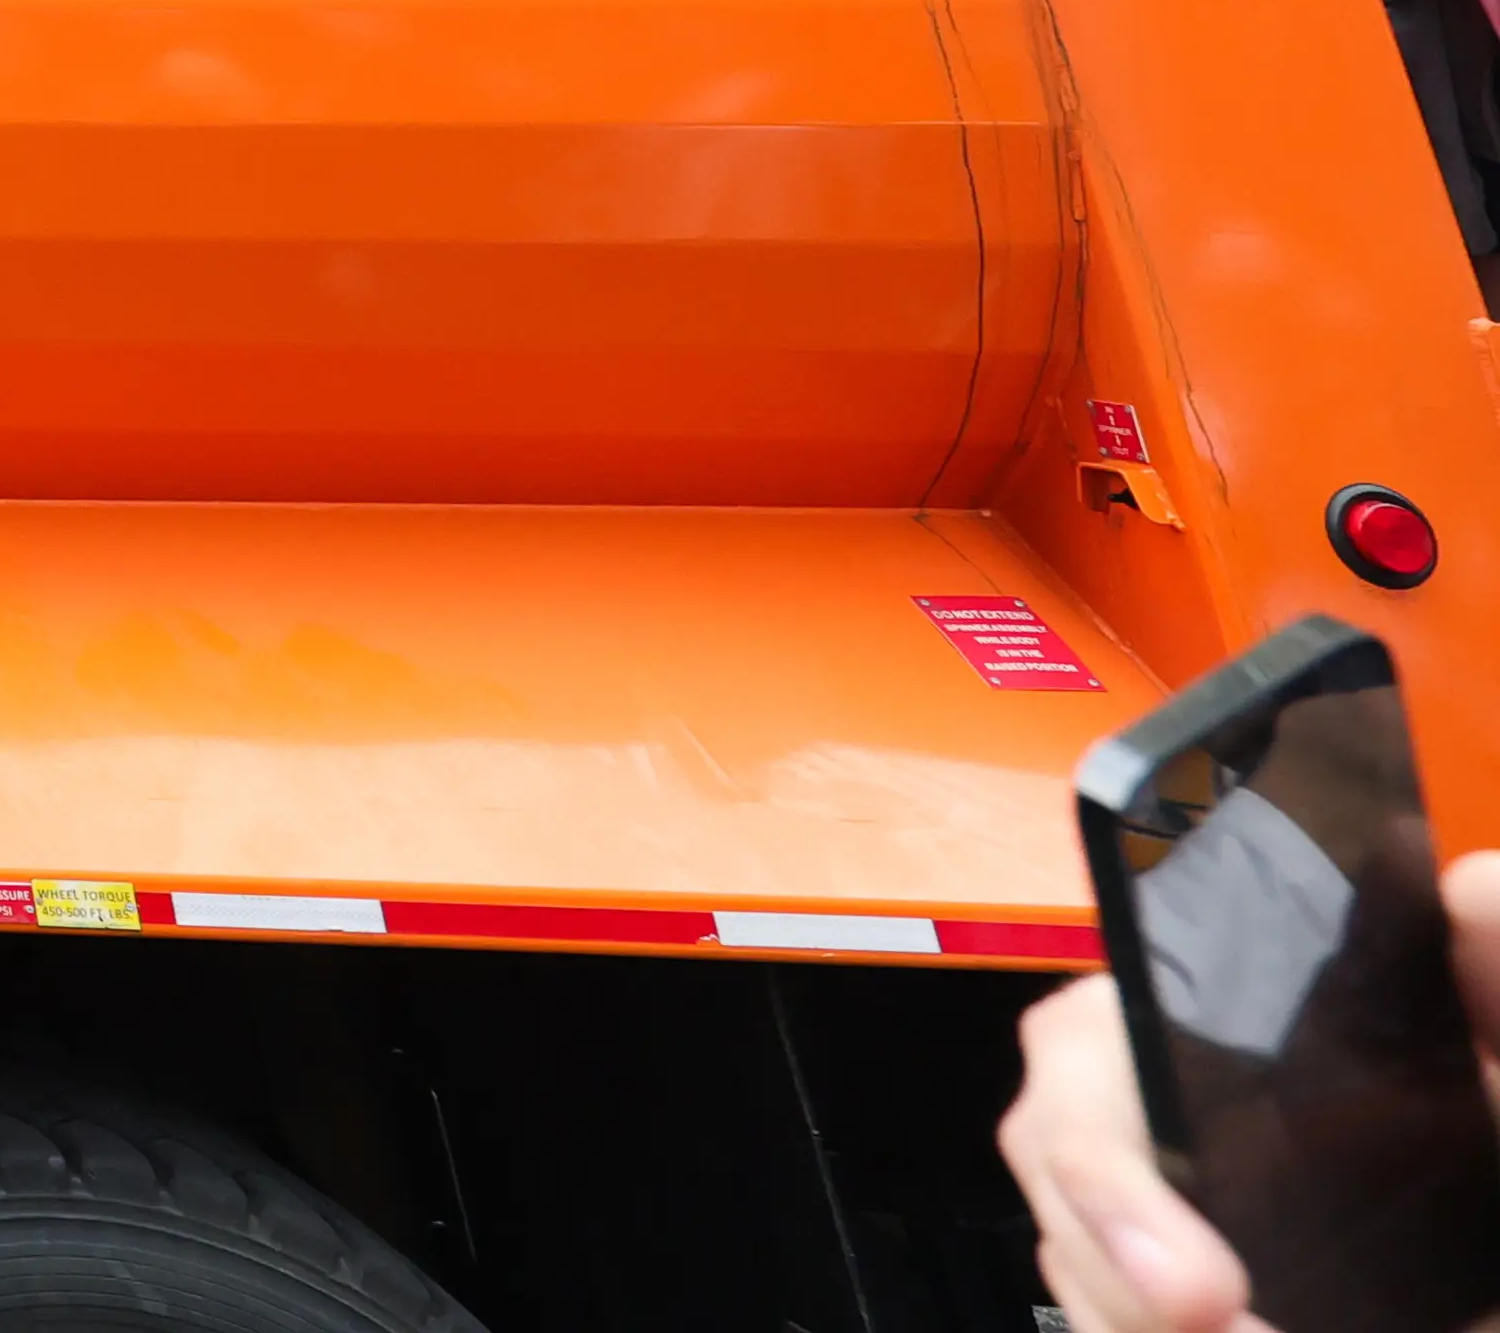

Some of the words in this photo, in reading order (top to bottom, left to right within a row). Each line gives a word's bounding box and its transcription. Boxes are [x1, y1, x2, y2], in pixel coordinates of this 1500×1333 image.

[931, 610, 952, 620] DO
[954, 610, 981, 620] NOT
[982, 610, 1034, 621] EXTEND
[973, 636, 1011, 645] WHILE
[1013, 636, 1040, 645] BODY
[984, 662, 1028, 672] RAISED
[1027, 662, 1079, 672] POSITION
[37, 889, 78, 902] WHEEL
[83, 889, 131, 902] TORQUE
[41, 906, 86, 919] 450-500
[90, 906, 104, 919] FT.
[109, 906, 131, 919] LBS.
